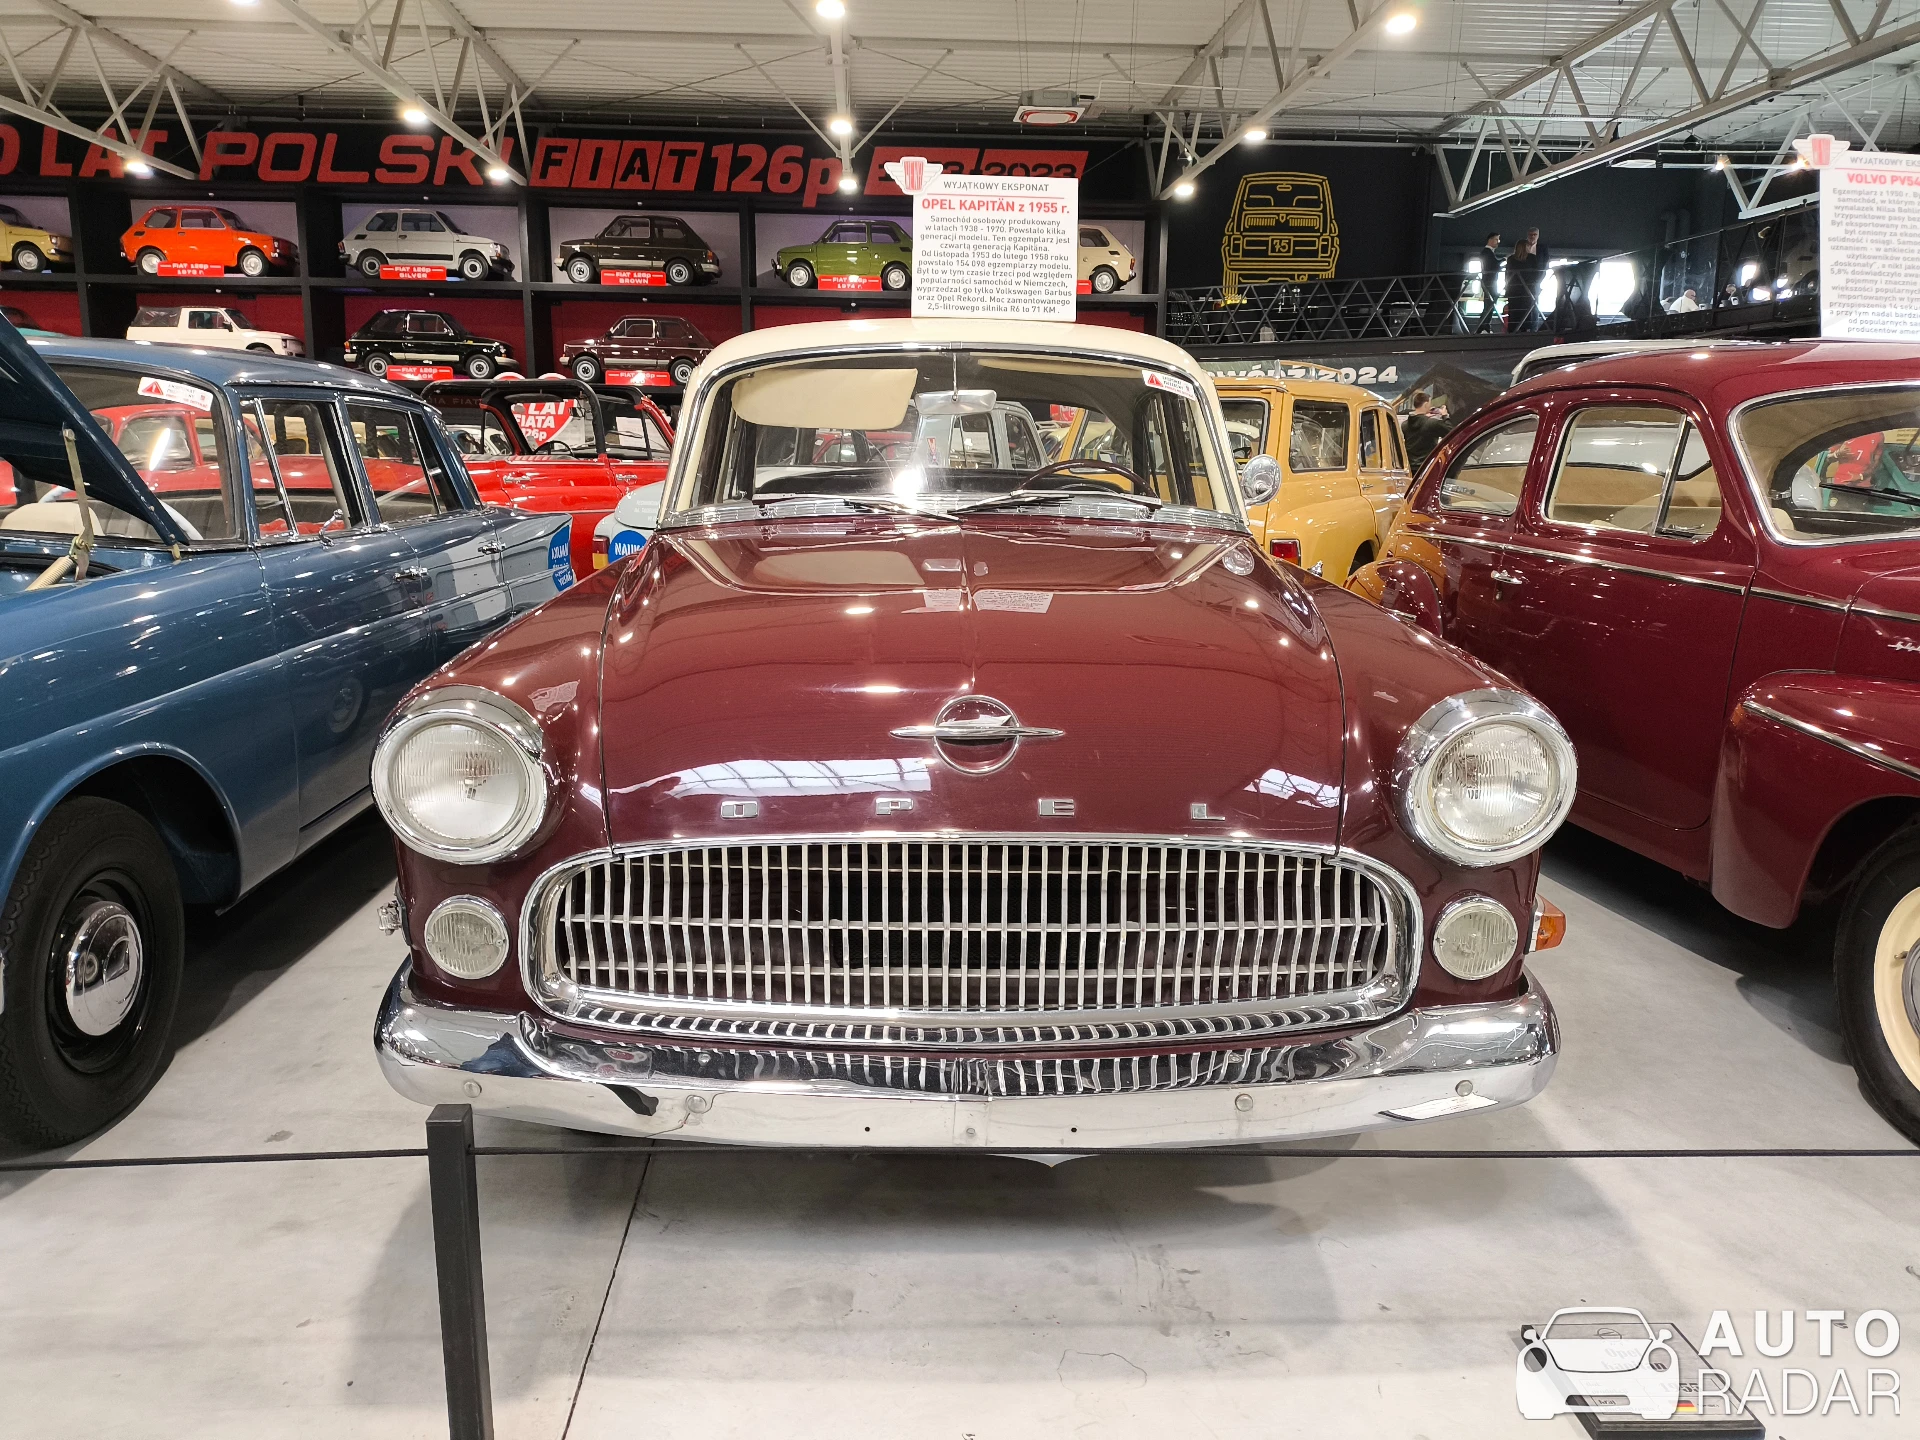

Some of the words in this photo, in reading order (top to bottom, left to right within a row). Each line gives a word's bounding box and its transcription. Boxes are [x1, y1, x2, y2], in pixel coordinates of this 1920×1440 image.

[1850, 156, 1903, 166] WYJĄTKOWY
[200, 131, 514, 186] POLSKI
[534, 140, 700, 188] FIAT
[711, 143, 844, 208] 126p
[1847, 173, 1887, 185] VOLVO
[943, 181, 999, 191] WYJĄTKOWY
[1001, 183, 1049, 192] EKSPONAT
[1832, 187, 1878, 196] Egzemplarz
[922, 198, 955, 210] OPEL
[959, 197, 1015, 212] KAPITÄN
[1018, 203, 1025, 213] z
[1029, 202, 1058, 214] 1955
[1061, 205, 1070, 214] r.
[1888, 198, 1916, 206] którym
[1834, 212, 1887, 220] trzypunktowe
[930, 215, 971, 223] Samochód
[972, 217, 1007, 226] osobowy
[1008, 218, 1061, 228] produkowany
[1845, 220, 1899, 230] eksportowany
[986, 225, 1007, 233] 1970.
[1046, 227, 1066, 235] kilka
[1858, 230, 1887, 238] ceniony
[920, 233, 957, 242] generacji
[958, 234, 990, 242] modelu.
[992, 234, 1006, 242] Ten
[1008, 235, 1054, 244] egzemplarz
[1055, 236, 1070, 245] jest
[1827, 235, 1864, 243] solidność
[939, 243, 971, 251] czwartą
[972, 243, 1011, 252] generacją
[1013, 243, 1050, 252] Kapitäna.
[933, 250, 970, 259] listopada
[972, 251, 990, 259] 1953
[1003, 252, 1028, 261] lutego
[1030, 253, 1049, 261] 1958
[1846, 253, 1901, 262] użytkowników
[955, 259, 970, 267] 154
[987, 261, 1038, 270] egzemplarzy
[1039, 262, 1071, 270] modelu.
[916, 267, 930, 275] Był
[1016, 270, 1031, 279] pod
[1032, 271, 1073, 280] względem
[1850, 269, 1902, 278] doświadczyło
[920, 276, 972, 285] popularności
[973, 278, 1013, 286] samochód
[1023, 279, 1068, 288] Niemczech,
[1845, 278, 1879, 286] pojemny
[974, 286, 994, 295] tylko
[995, 287, 1043, 296] Volkswagen
[1044, 288, 1073, 297] Garbus
[1831, 284, 1873, 293] większości
[936, 294, 955, 302] Opel
[956, 294, 988, 303] Rekord.
[989, 295, 1005, 303] Moc
[1006, 297, 1071, 306] zamontowanego
[1837, 293, 1897, 302] importowanych
[927, 302, 980, 312] 2,5-litrowego
[981, 304, 1008, 312] silnika
[1031, 305, 1041, 313] 71
[1829, 301, 1887, 309] przyspieszenia
[1859, 319, 1908, 327] popularnych
[1847, 326, 1898, 334] producentów
[1318, 366, 1398, 385] 2024
[1856, 450, 1864, 460] 7
[615, 543, 645, 556] NAUK
[720, 797, 1226, 821] OPEL
